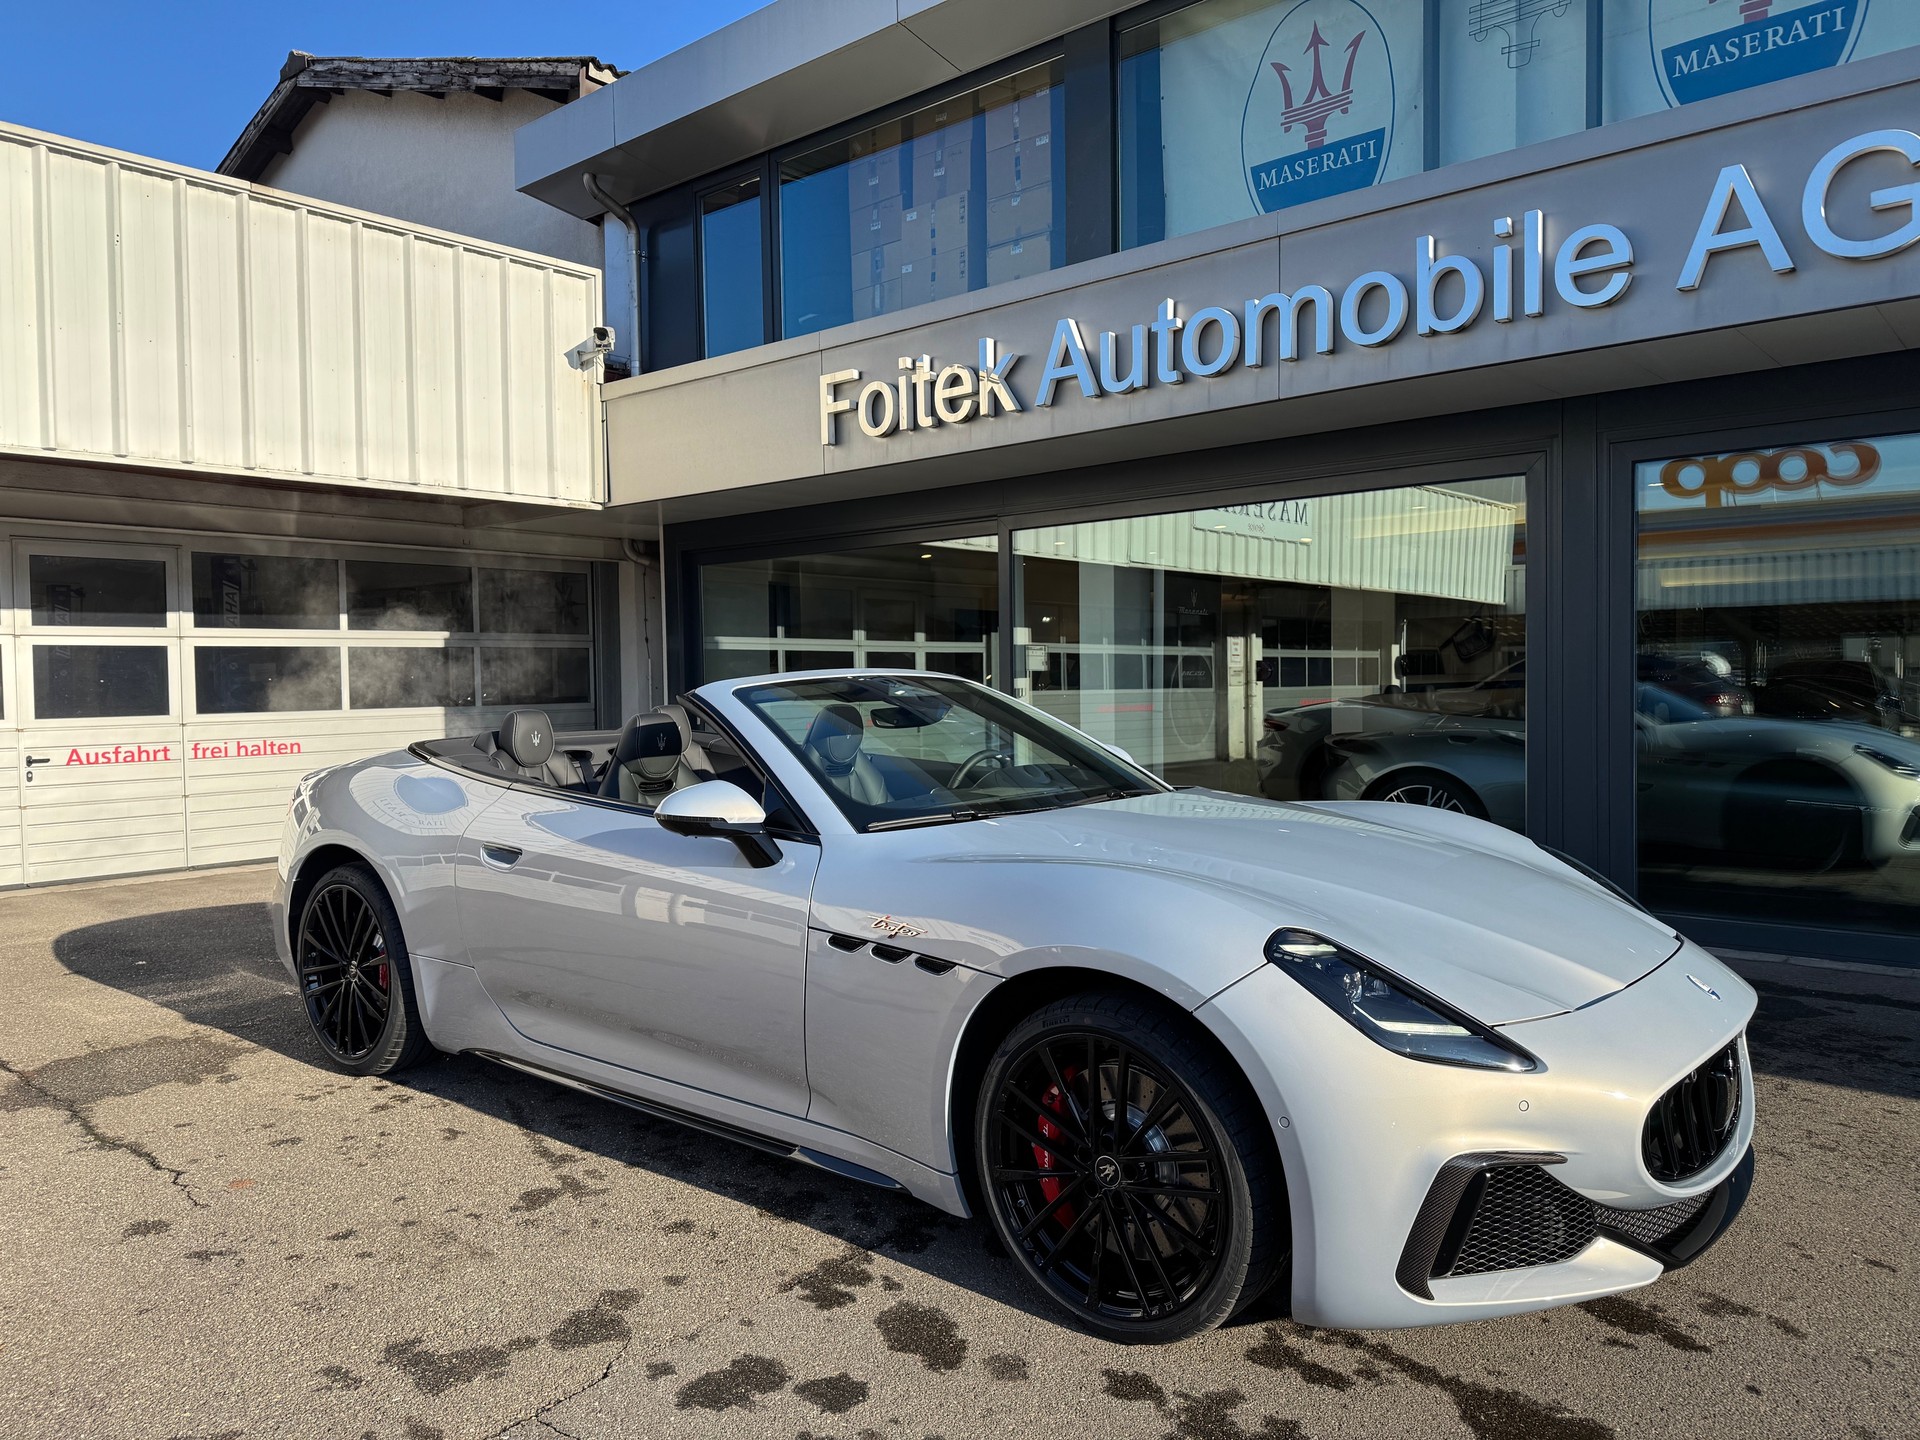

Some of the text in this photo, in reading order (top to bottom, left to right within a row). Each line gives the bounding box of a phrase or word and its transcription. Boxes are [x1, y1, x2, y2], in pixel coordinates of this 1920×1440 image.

[1672, 6, 1846, 78] MASERATI
[1258, 139, 1377, 191] MASERATI
[820, 128, 1920, 446] Foitek Automobile AG
[65, 739, 302, 766] Ausfahrt frei halten
